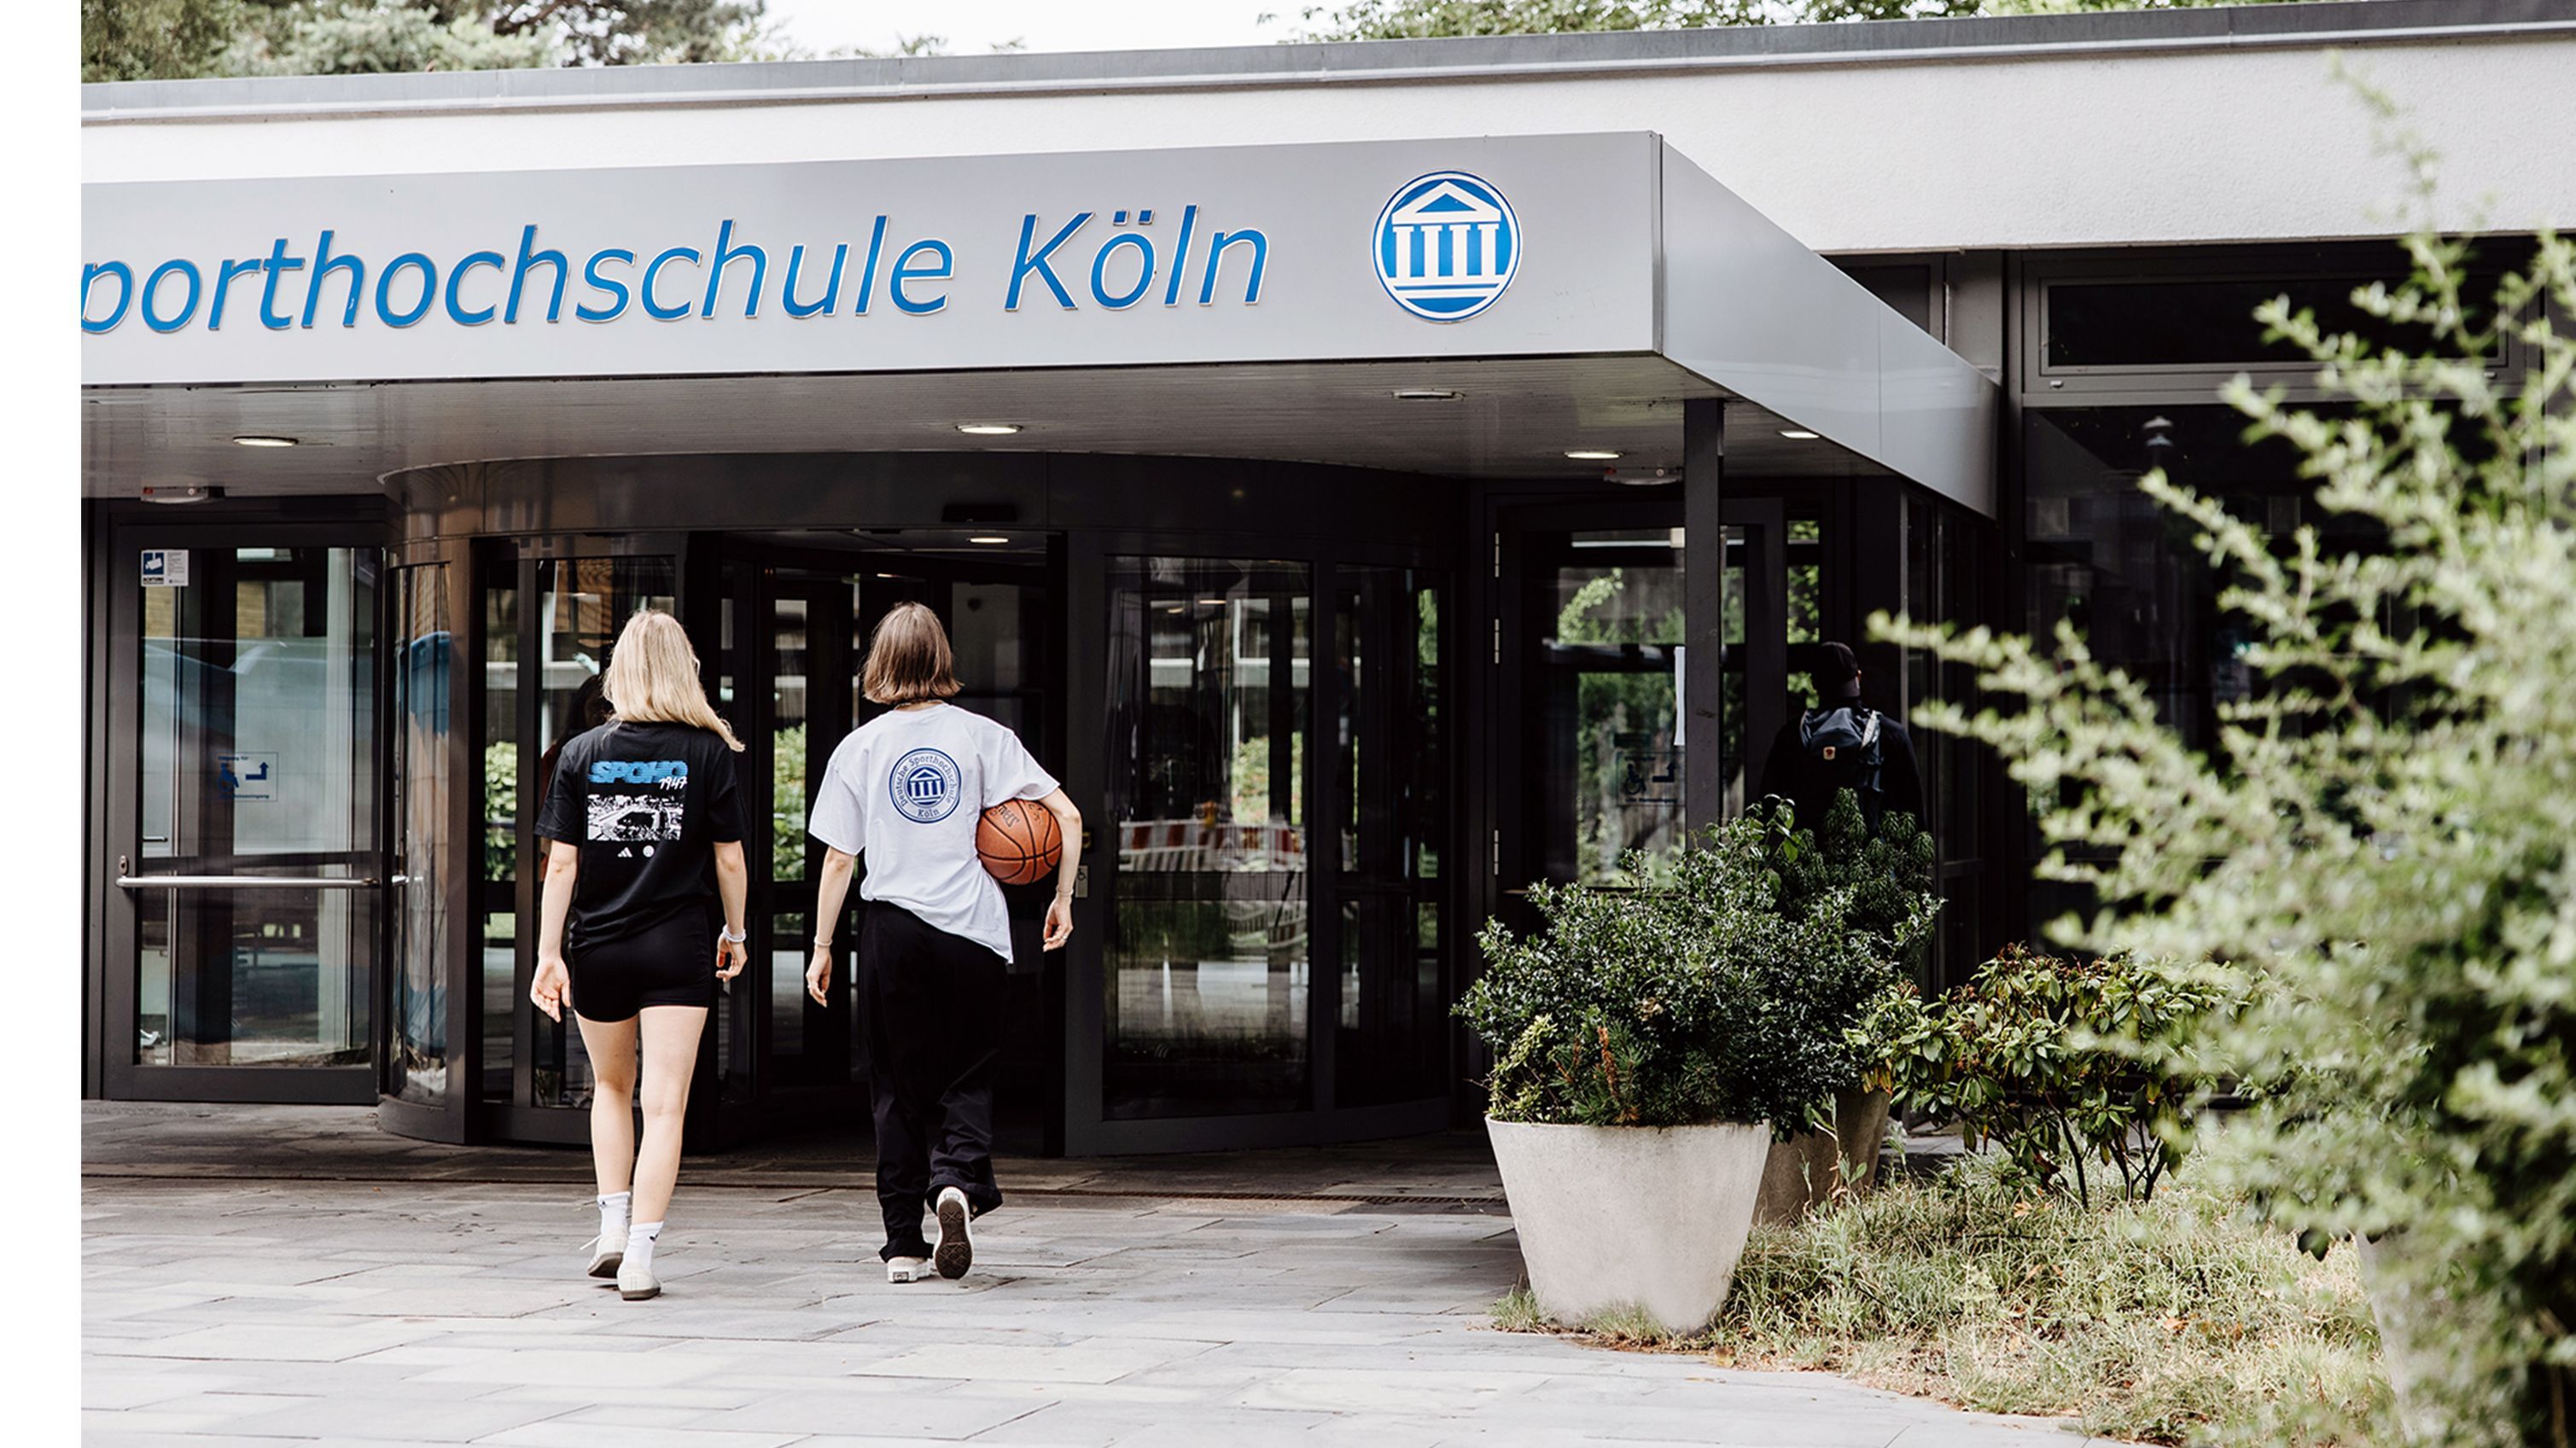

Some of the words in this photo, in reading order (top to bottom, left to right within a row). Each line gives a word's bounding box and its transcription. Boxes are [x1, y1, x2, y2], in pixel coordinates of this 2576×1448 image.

[81, 215, 954, 334] porthochschule
[1004, 204, 1268, 311] Köln
[587, 760, 688, 784] SPOHO
[658, 776, 688, 790] 1947
[895, 765, 910, 806] Deutsche
[909, 755, 957, 804] Sporthochschule
[918, 808, 940, 817] Köln
